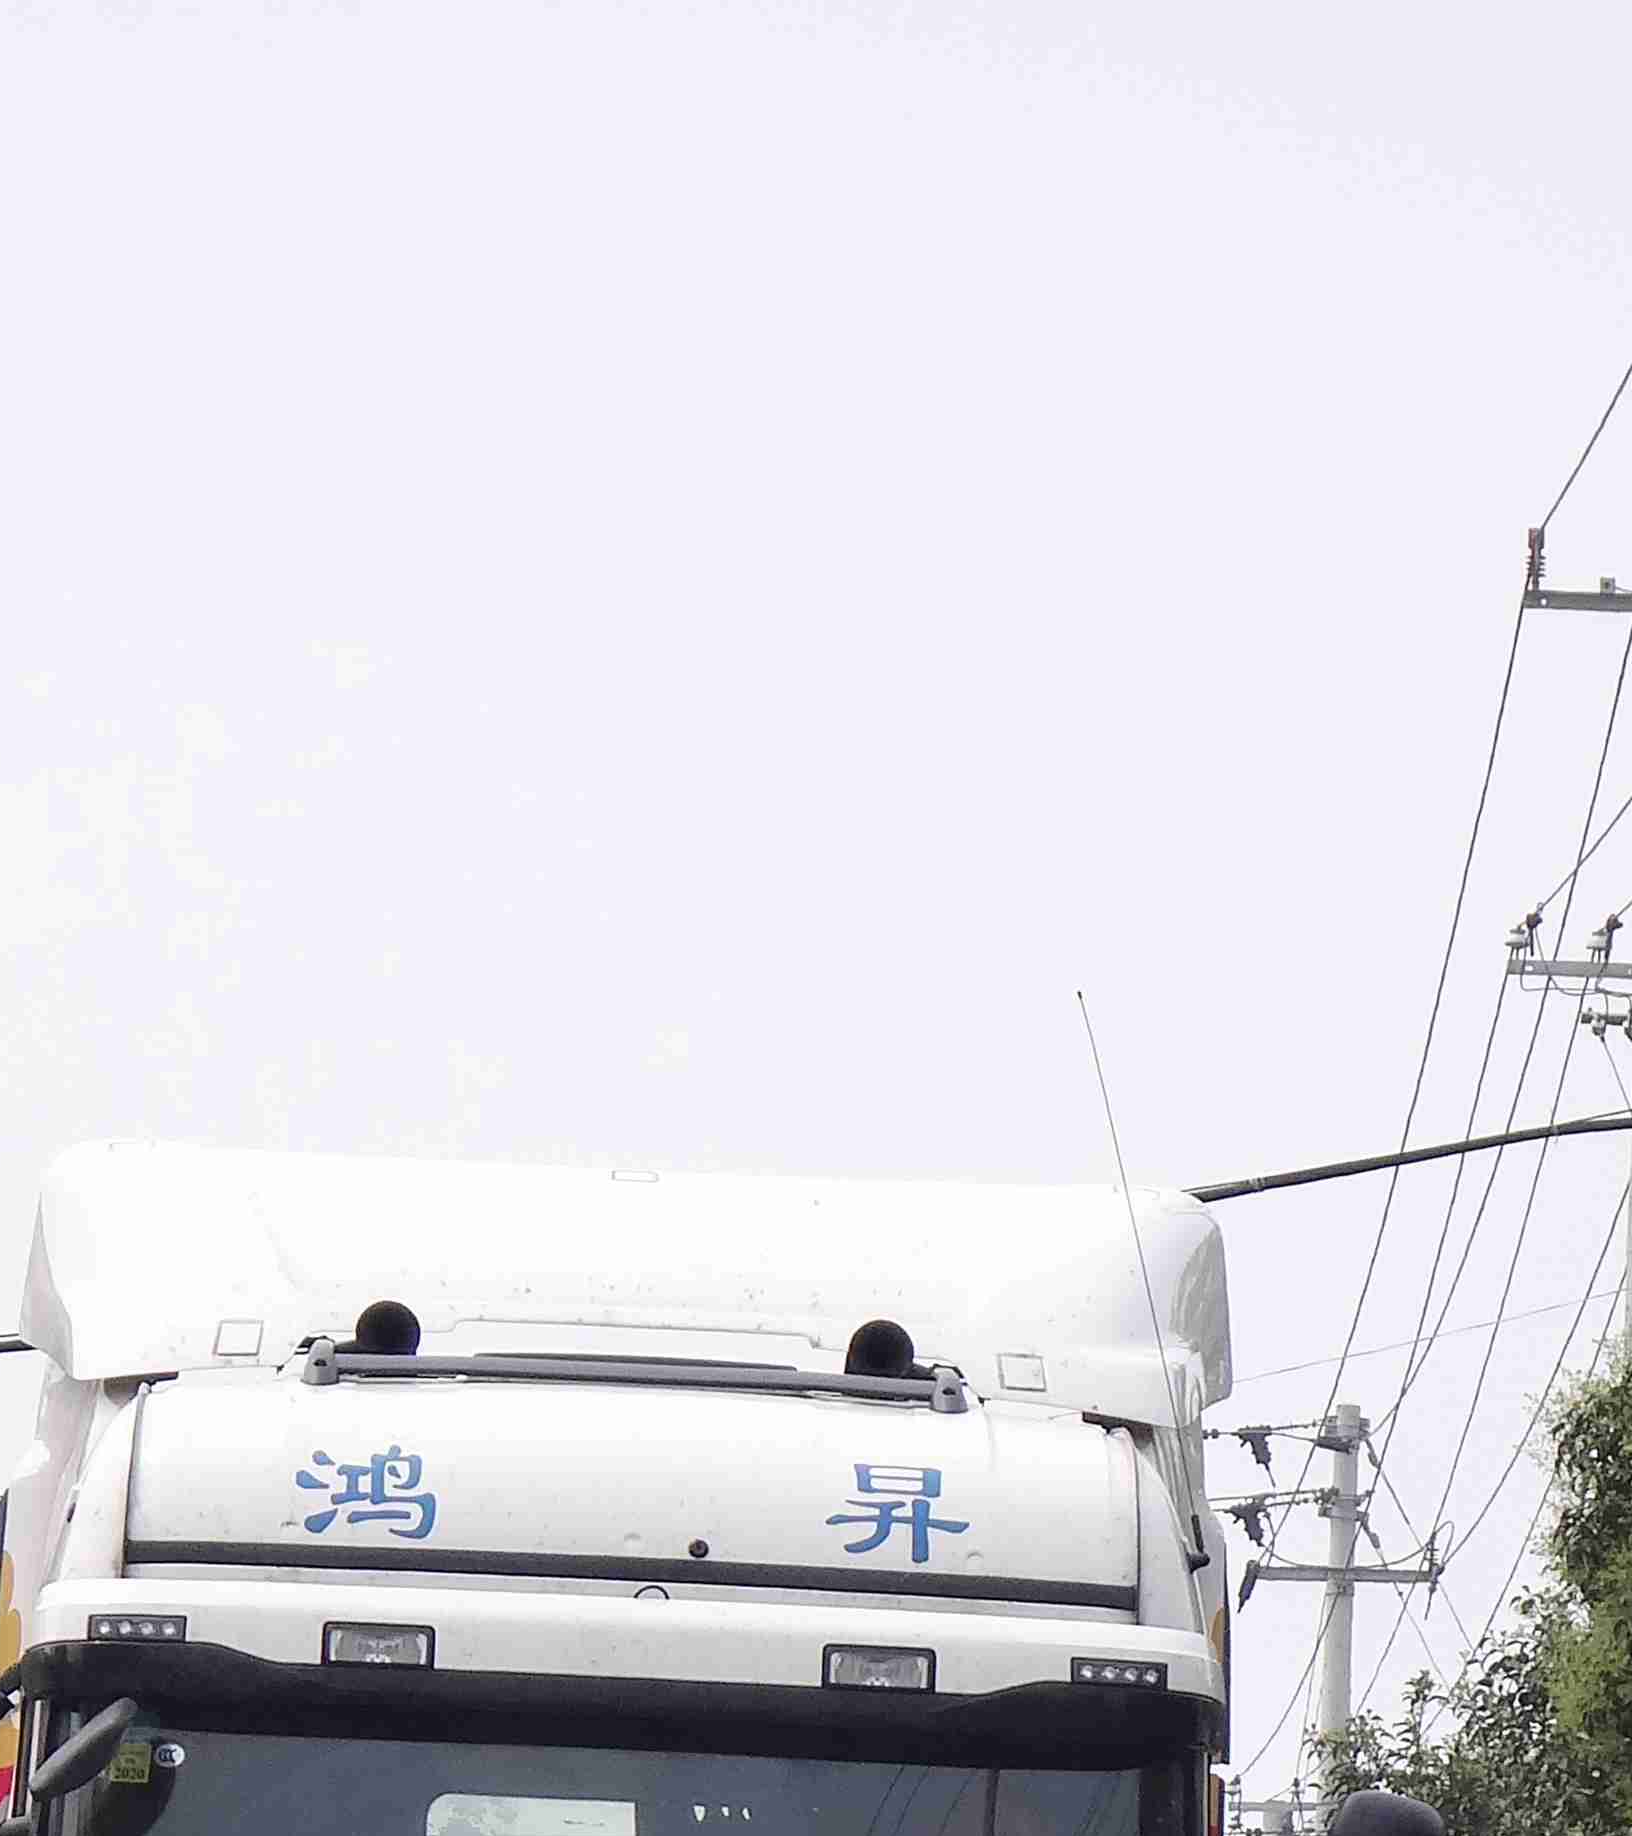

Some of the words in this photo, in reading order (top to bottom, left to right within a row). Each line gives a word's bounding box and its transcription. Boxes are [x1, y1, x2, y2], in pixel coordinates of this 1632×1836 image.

[296, 1445, 437, 1540] 鸿
[826, 1463, 970, 1564] 昇
[113, 1767, 146, 1780] 2020
